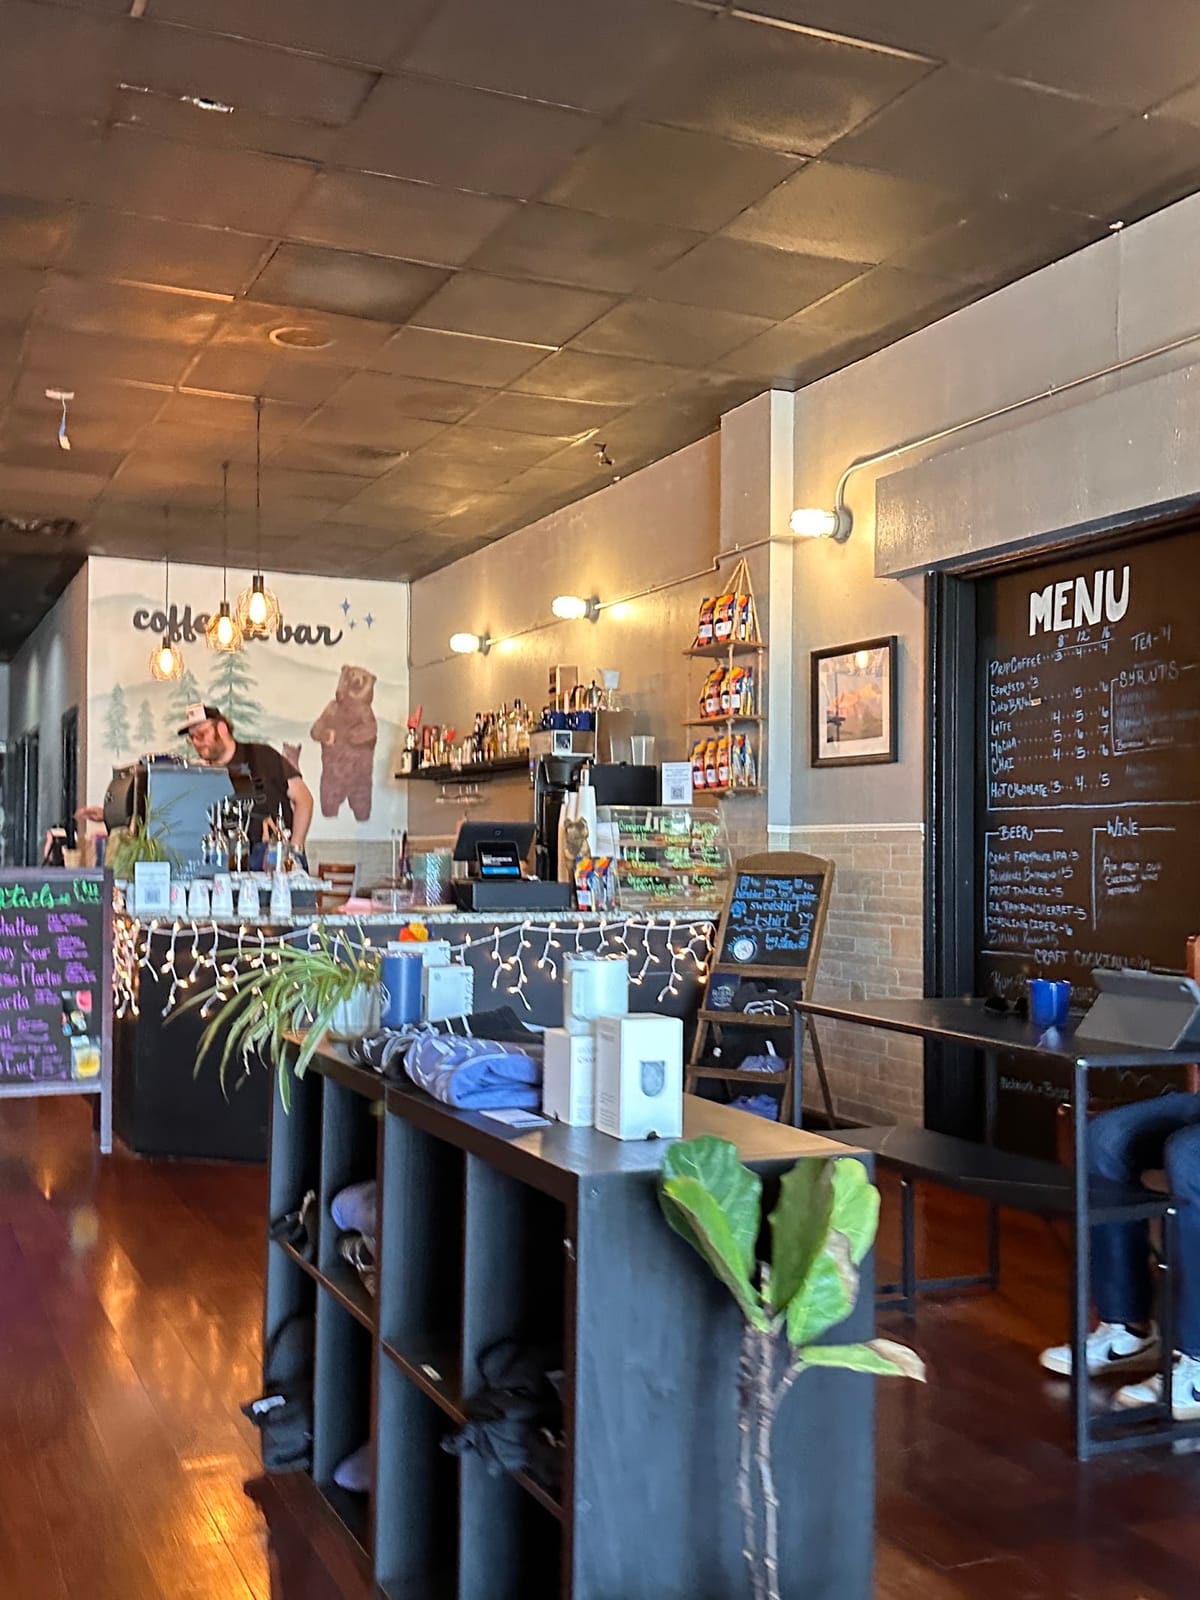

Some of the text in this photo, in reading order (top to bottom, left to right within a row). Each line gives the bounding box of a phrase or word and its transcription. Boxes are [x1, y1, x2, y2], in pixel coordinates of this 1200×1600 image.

[1029, 566, 1130, 637] MENU
[133, 604, 212, 643] coffe
[276, 613, 343, 646] bar
[1131, 632, 1152, 651] TEA
[1054, 651, 1063, 661] 3
[991, 720, 1012, 736] LATTE
[1053, 709, 1061, 724] 4
[1075, 710, 1084, 722] 5
[991, 737, 1017, 758] MOCHA
[1053, 729, 1063, 743] 5
[991, 757, 1015, 775] CHAI
[1053, 747, 1061, 761] 4
[1075, 746, 1086, 759] 5
[991, 772, 1111, 799] HOT CHOCOLATE 3 4 5
[999, 825, 1033, 841] BEER
[1106, 816, 1139, 837] WINE
[750, 900, 800, 912] sweatshirt
[1034, 948, 1068, 966] CRAFT
